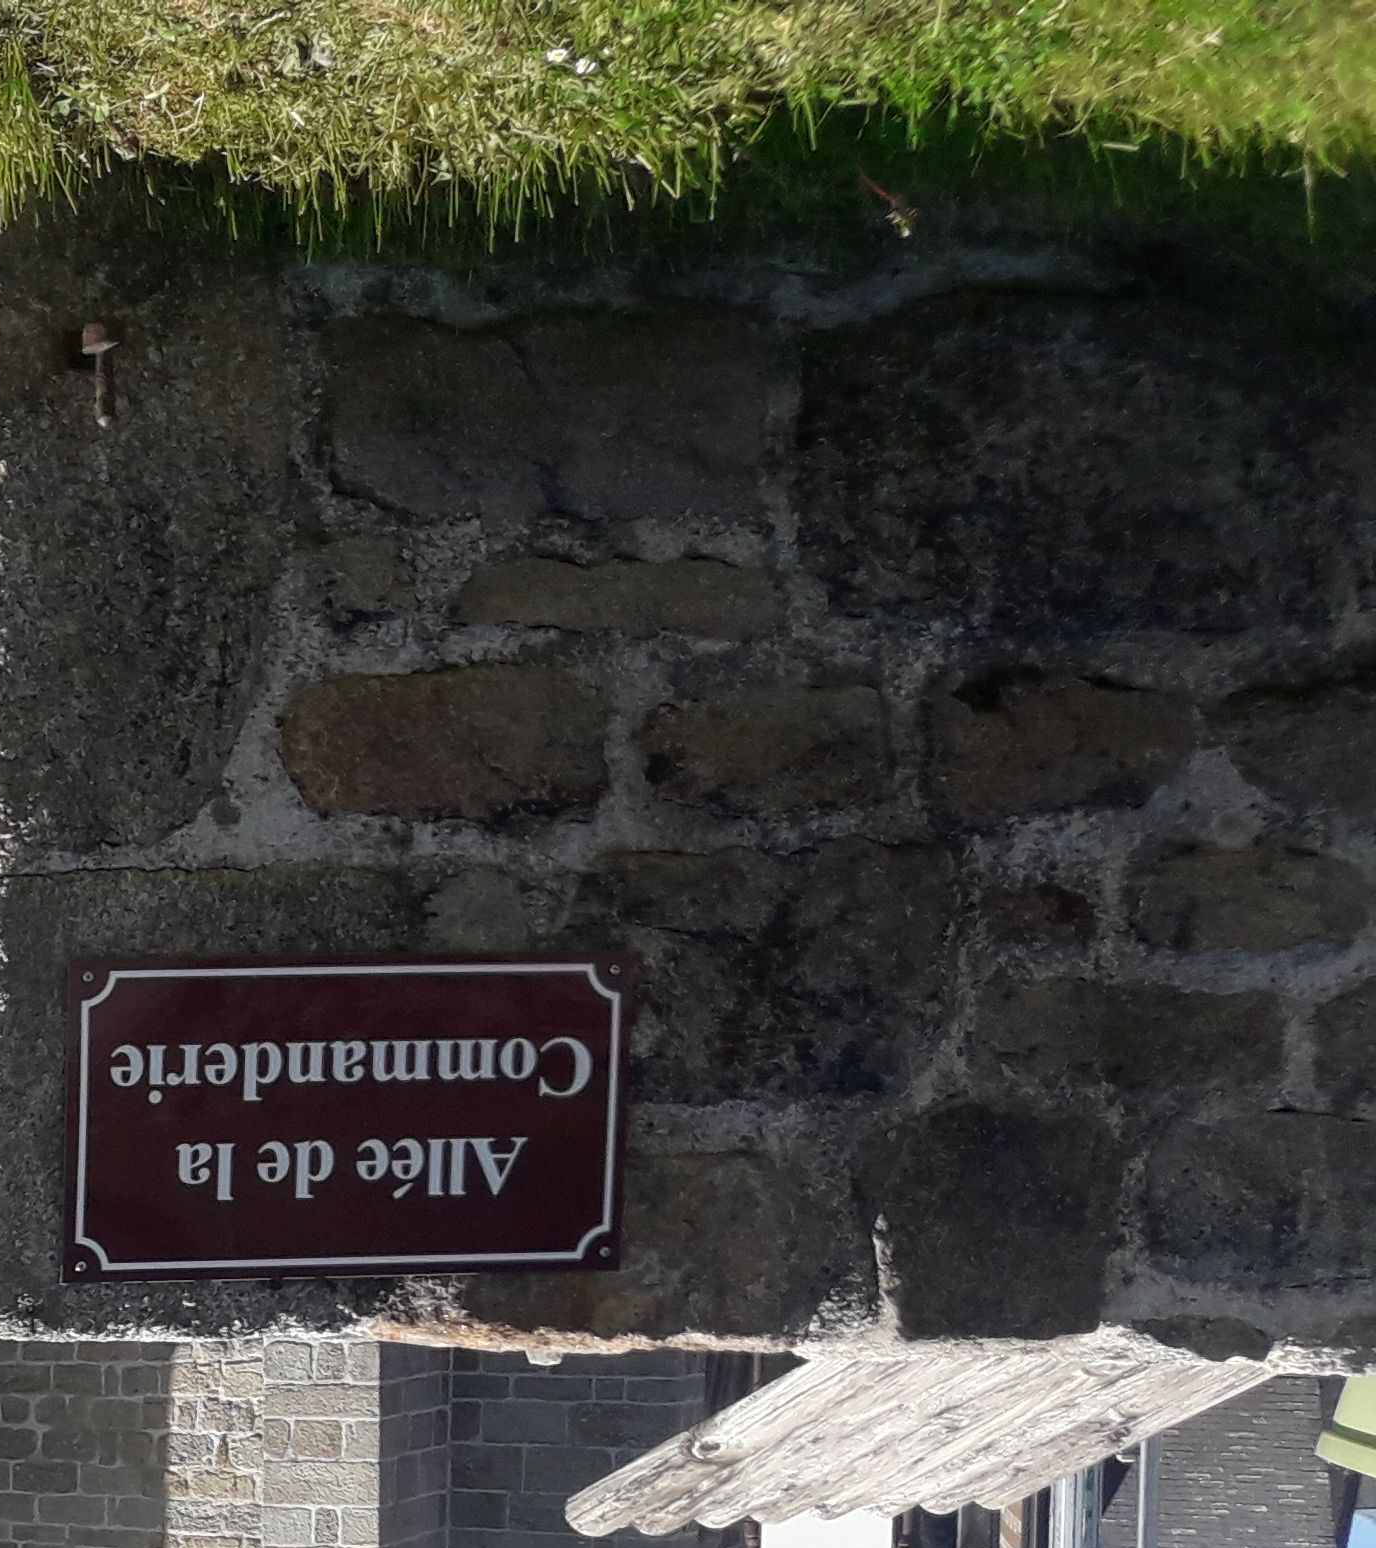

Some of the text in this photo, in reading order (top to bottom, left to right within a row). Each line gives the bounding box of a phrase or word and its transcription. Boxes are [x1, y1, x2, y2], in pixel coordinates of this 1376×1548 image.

[109, 1036, 592, 1105] Commanderie
[174, 1136, 528, 1202] Allée de la
